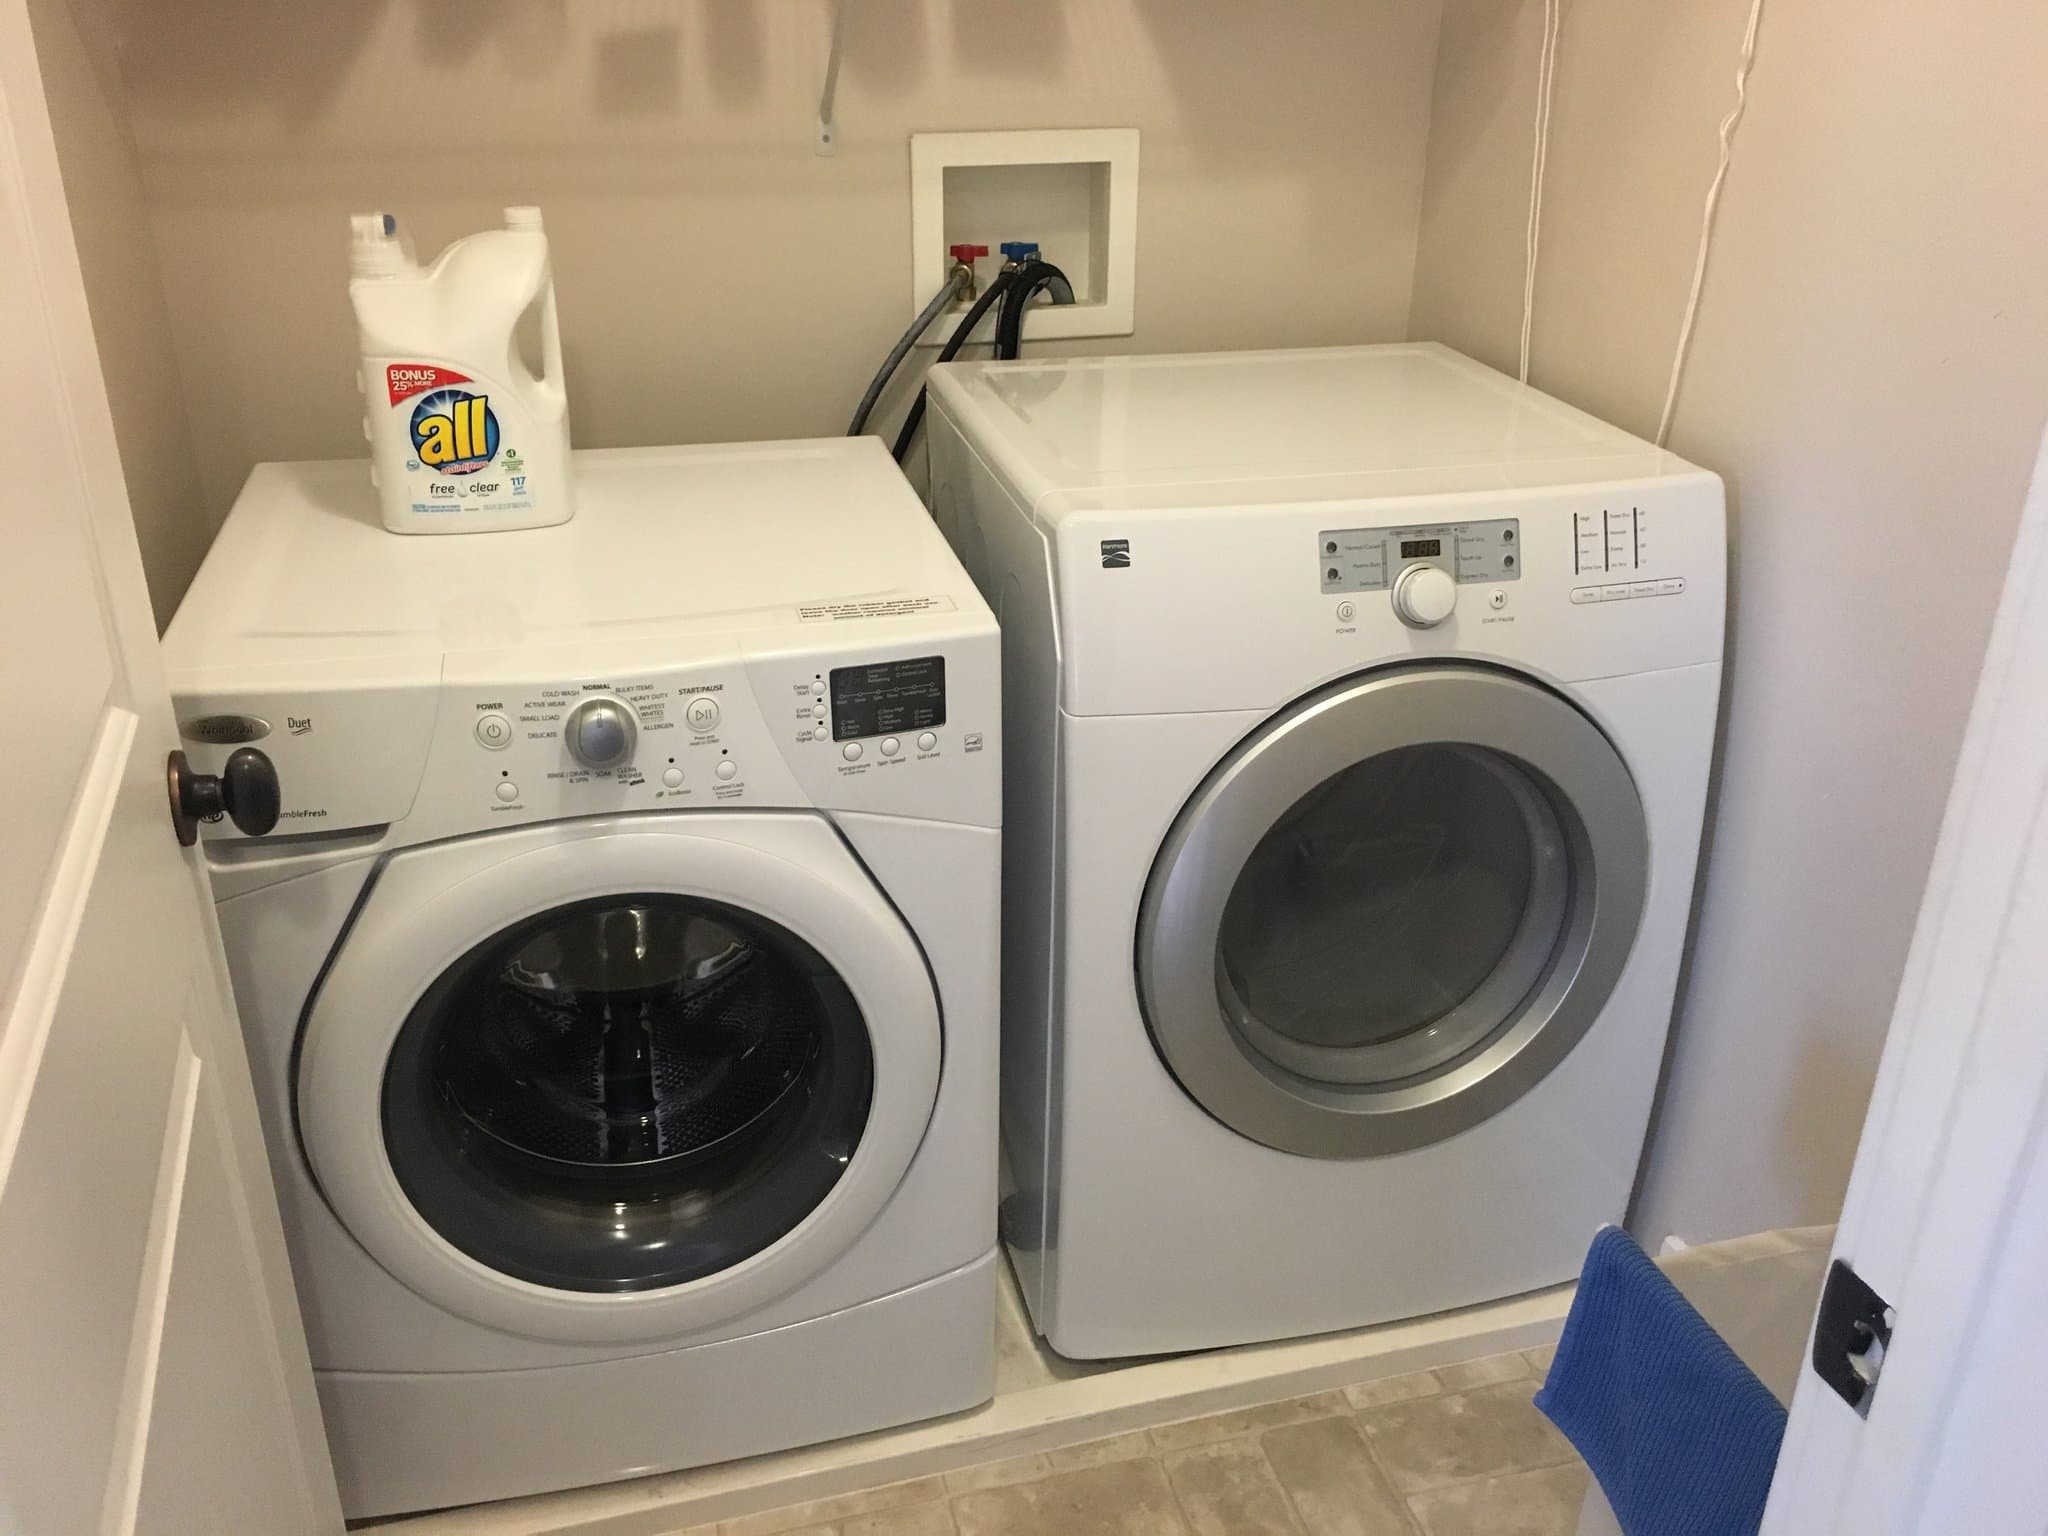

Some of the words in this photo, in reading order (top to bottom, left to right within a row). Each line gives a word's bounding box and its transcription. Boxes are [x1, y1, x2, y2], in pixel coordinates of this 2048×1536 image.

[390, 370, 436, 380] BONUS
[393, 381, 413, 390] 25%
[417, 395, 488, 465] all
[511, 476, 526, 485] 117
[430, 483, 455, 494] free
[470, 482, 500, 494] clear
[678, 683, 723, 695] START/PAUSE
[288, 717, 311, 729] Duet
[280, 809, 327, 819] umbleFresh
